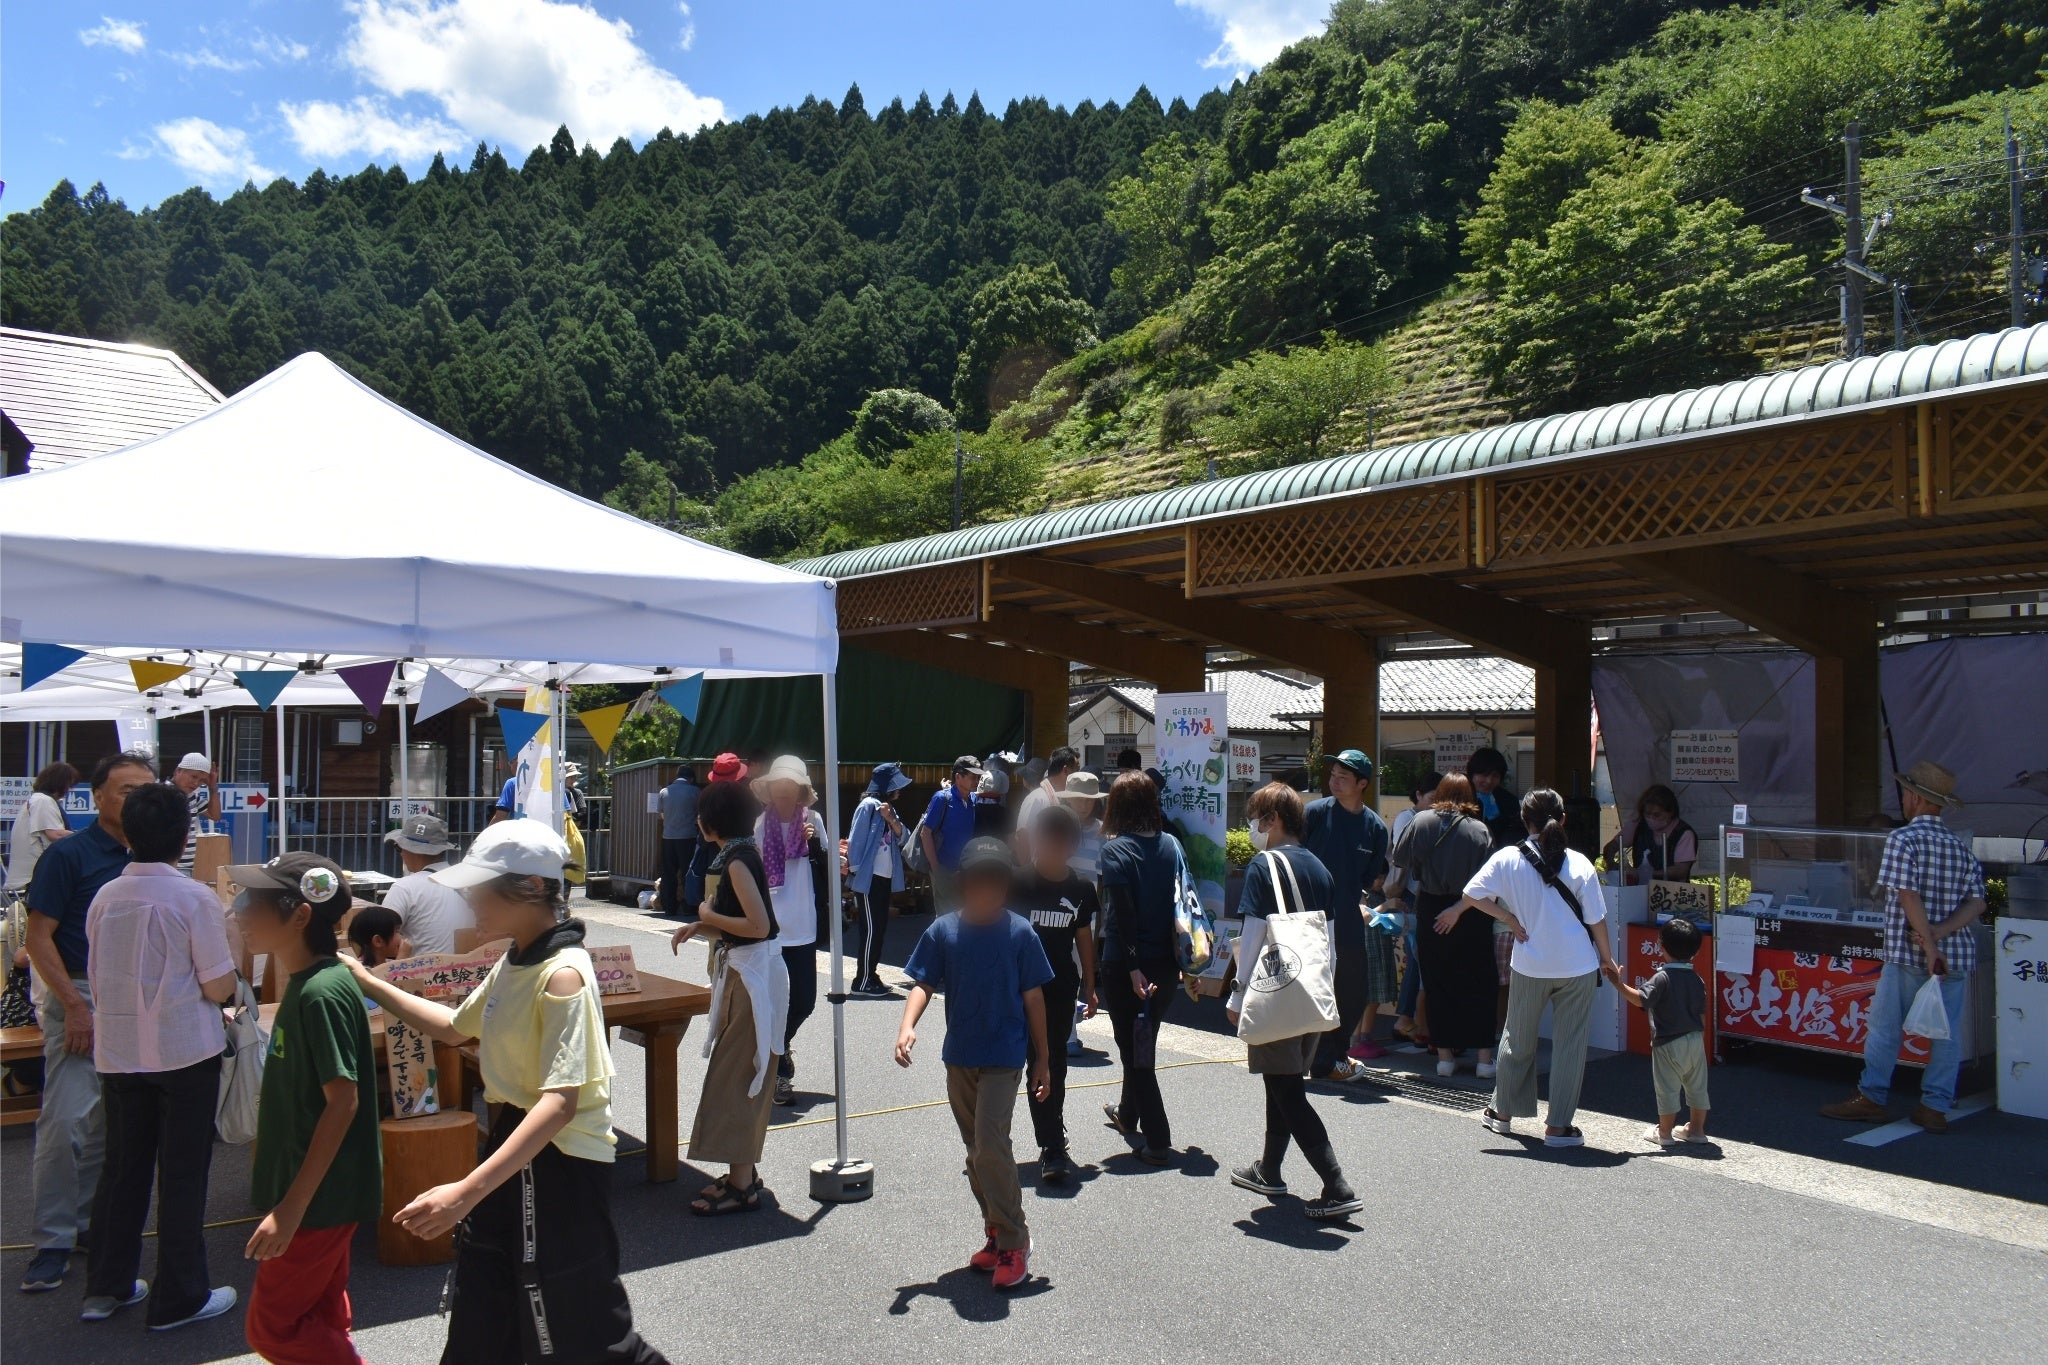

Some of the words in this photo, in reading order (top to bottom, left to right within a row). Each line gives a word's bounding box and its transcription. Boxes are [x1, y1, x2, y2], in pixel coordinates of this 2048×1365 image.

[1164, 718, 1212, 736] かわかみ
[1160, 759, 1201, 781] 手づくり
[1160, 785, 1222, 815] 柿の葉寿司
[1030, 909, 1074, 928] PUMA
